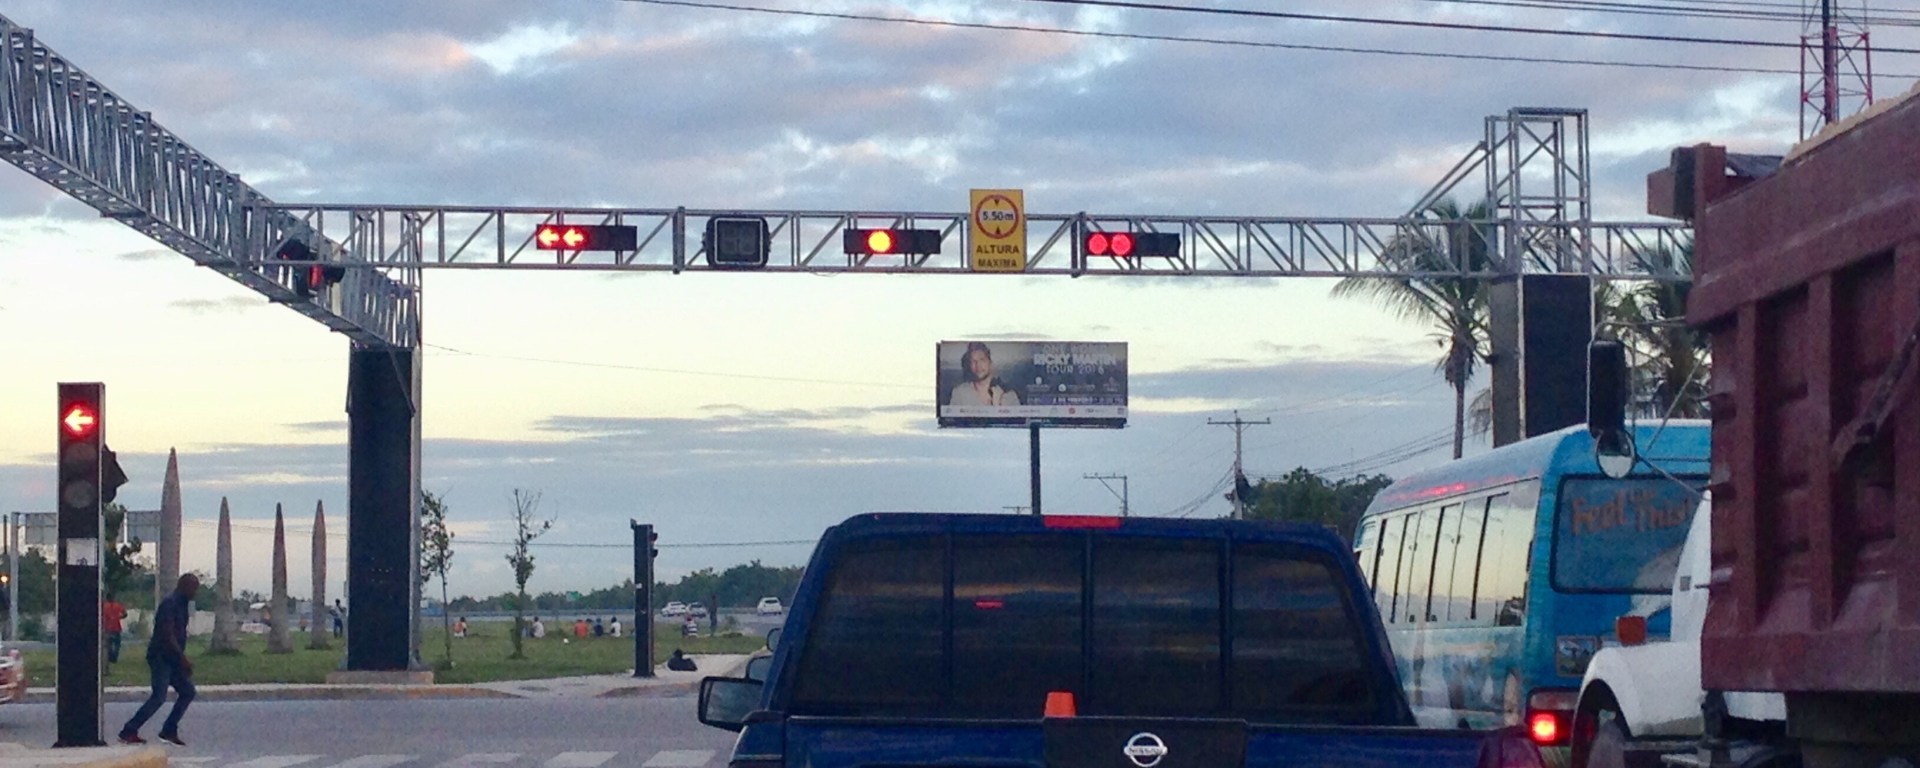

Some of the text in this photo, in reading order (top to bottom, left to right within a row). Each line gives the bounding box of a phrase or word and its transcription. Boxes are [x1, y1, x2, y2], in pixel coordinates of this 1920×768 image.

[976, 245, 1019, 254] ALTURA
[978, 258, 1017, 268] MAXIMA
[1034, 353, 1117, 365] RICKY MARTIN
[1046, 365, 1105, 376] TOUR 2016
[1571, 490, 1627, 537] Feel
